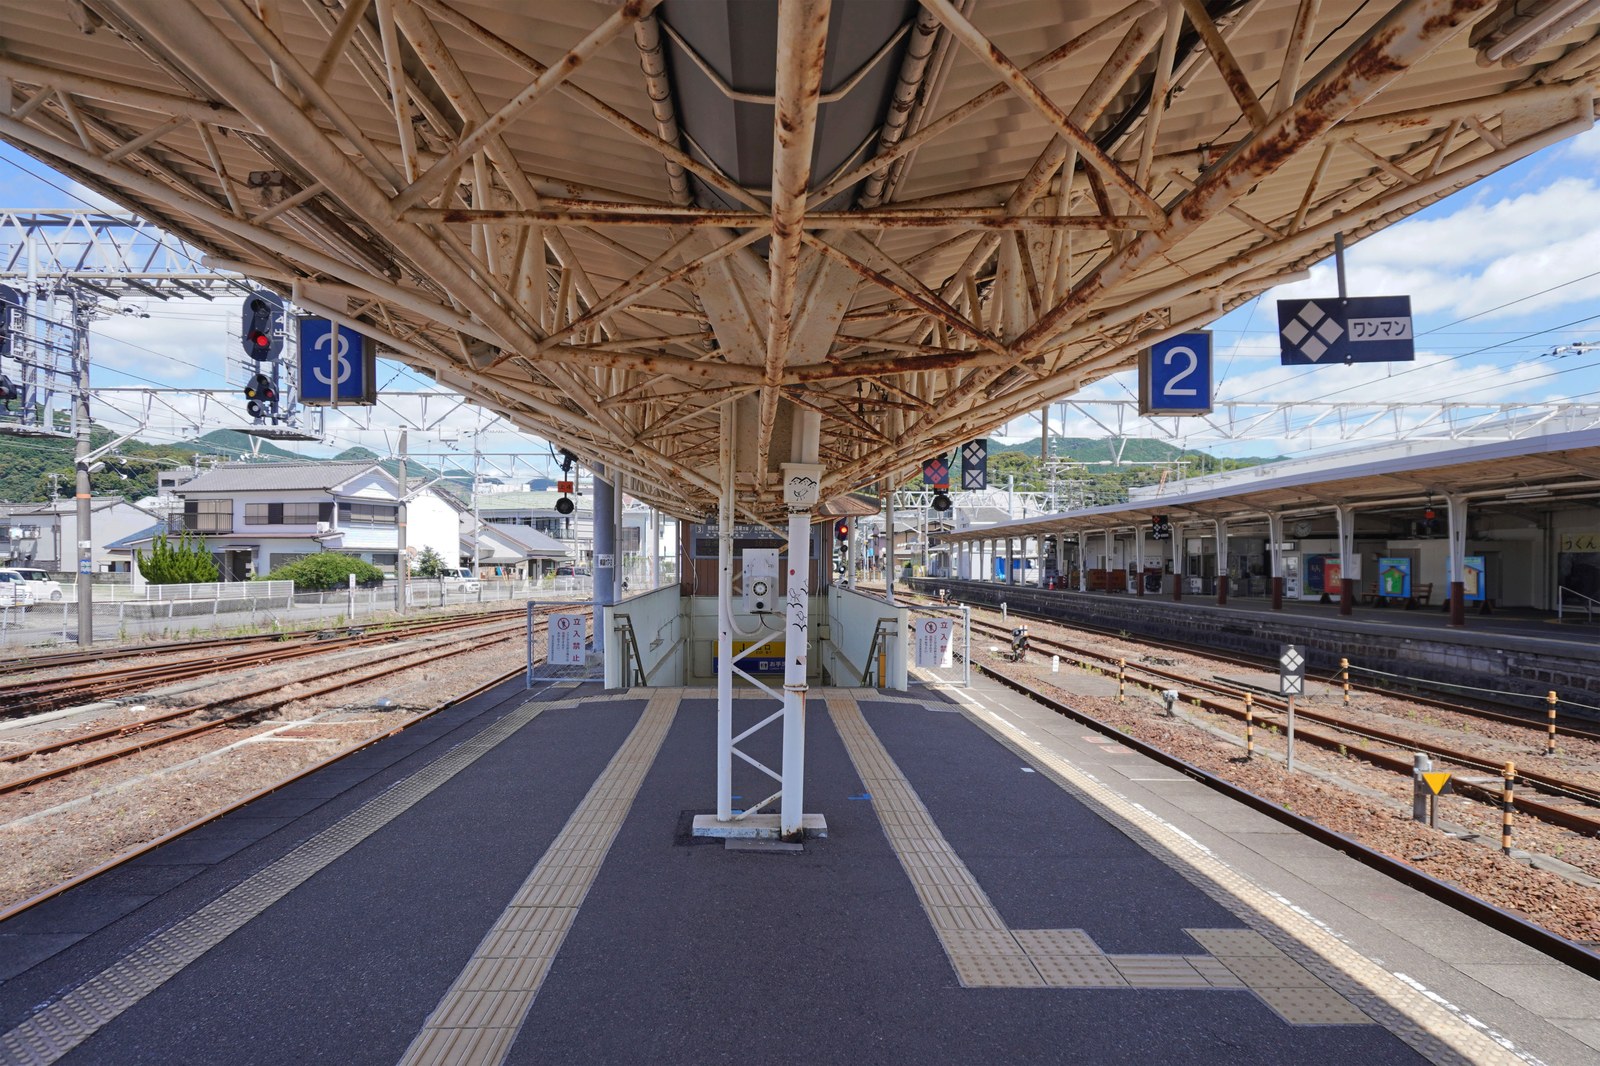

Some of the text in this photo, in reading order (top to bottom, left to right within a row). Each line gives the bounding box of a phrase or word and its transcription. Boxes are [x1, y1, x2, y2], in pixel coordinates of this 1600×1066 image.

[1352, 320, 1406, 338] ワンマン
[313, 332, 352, 385] 3
[1163, 346, 1198, 396] 2
[572, 618, 581, 662] 立入禁止
